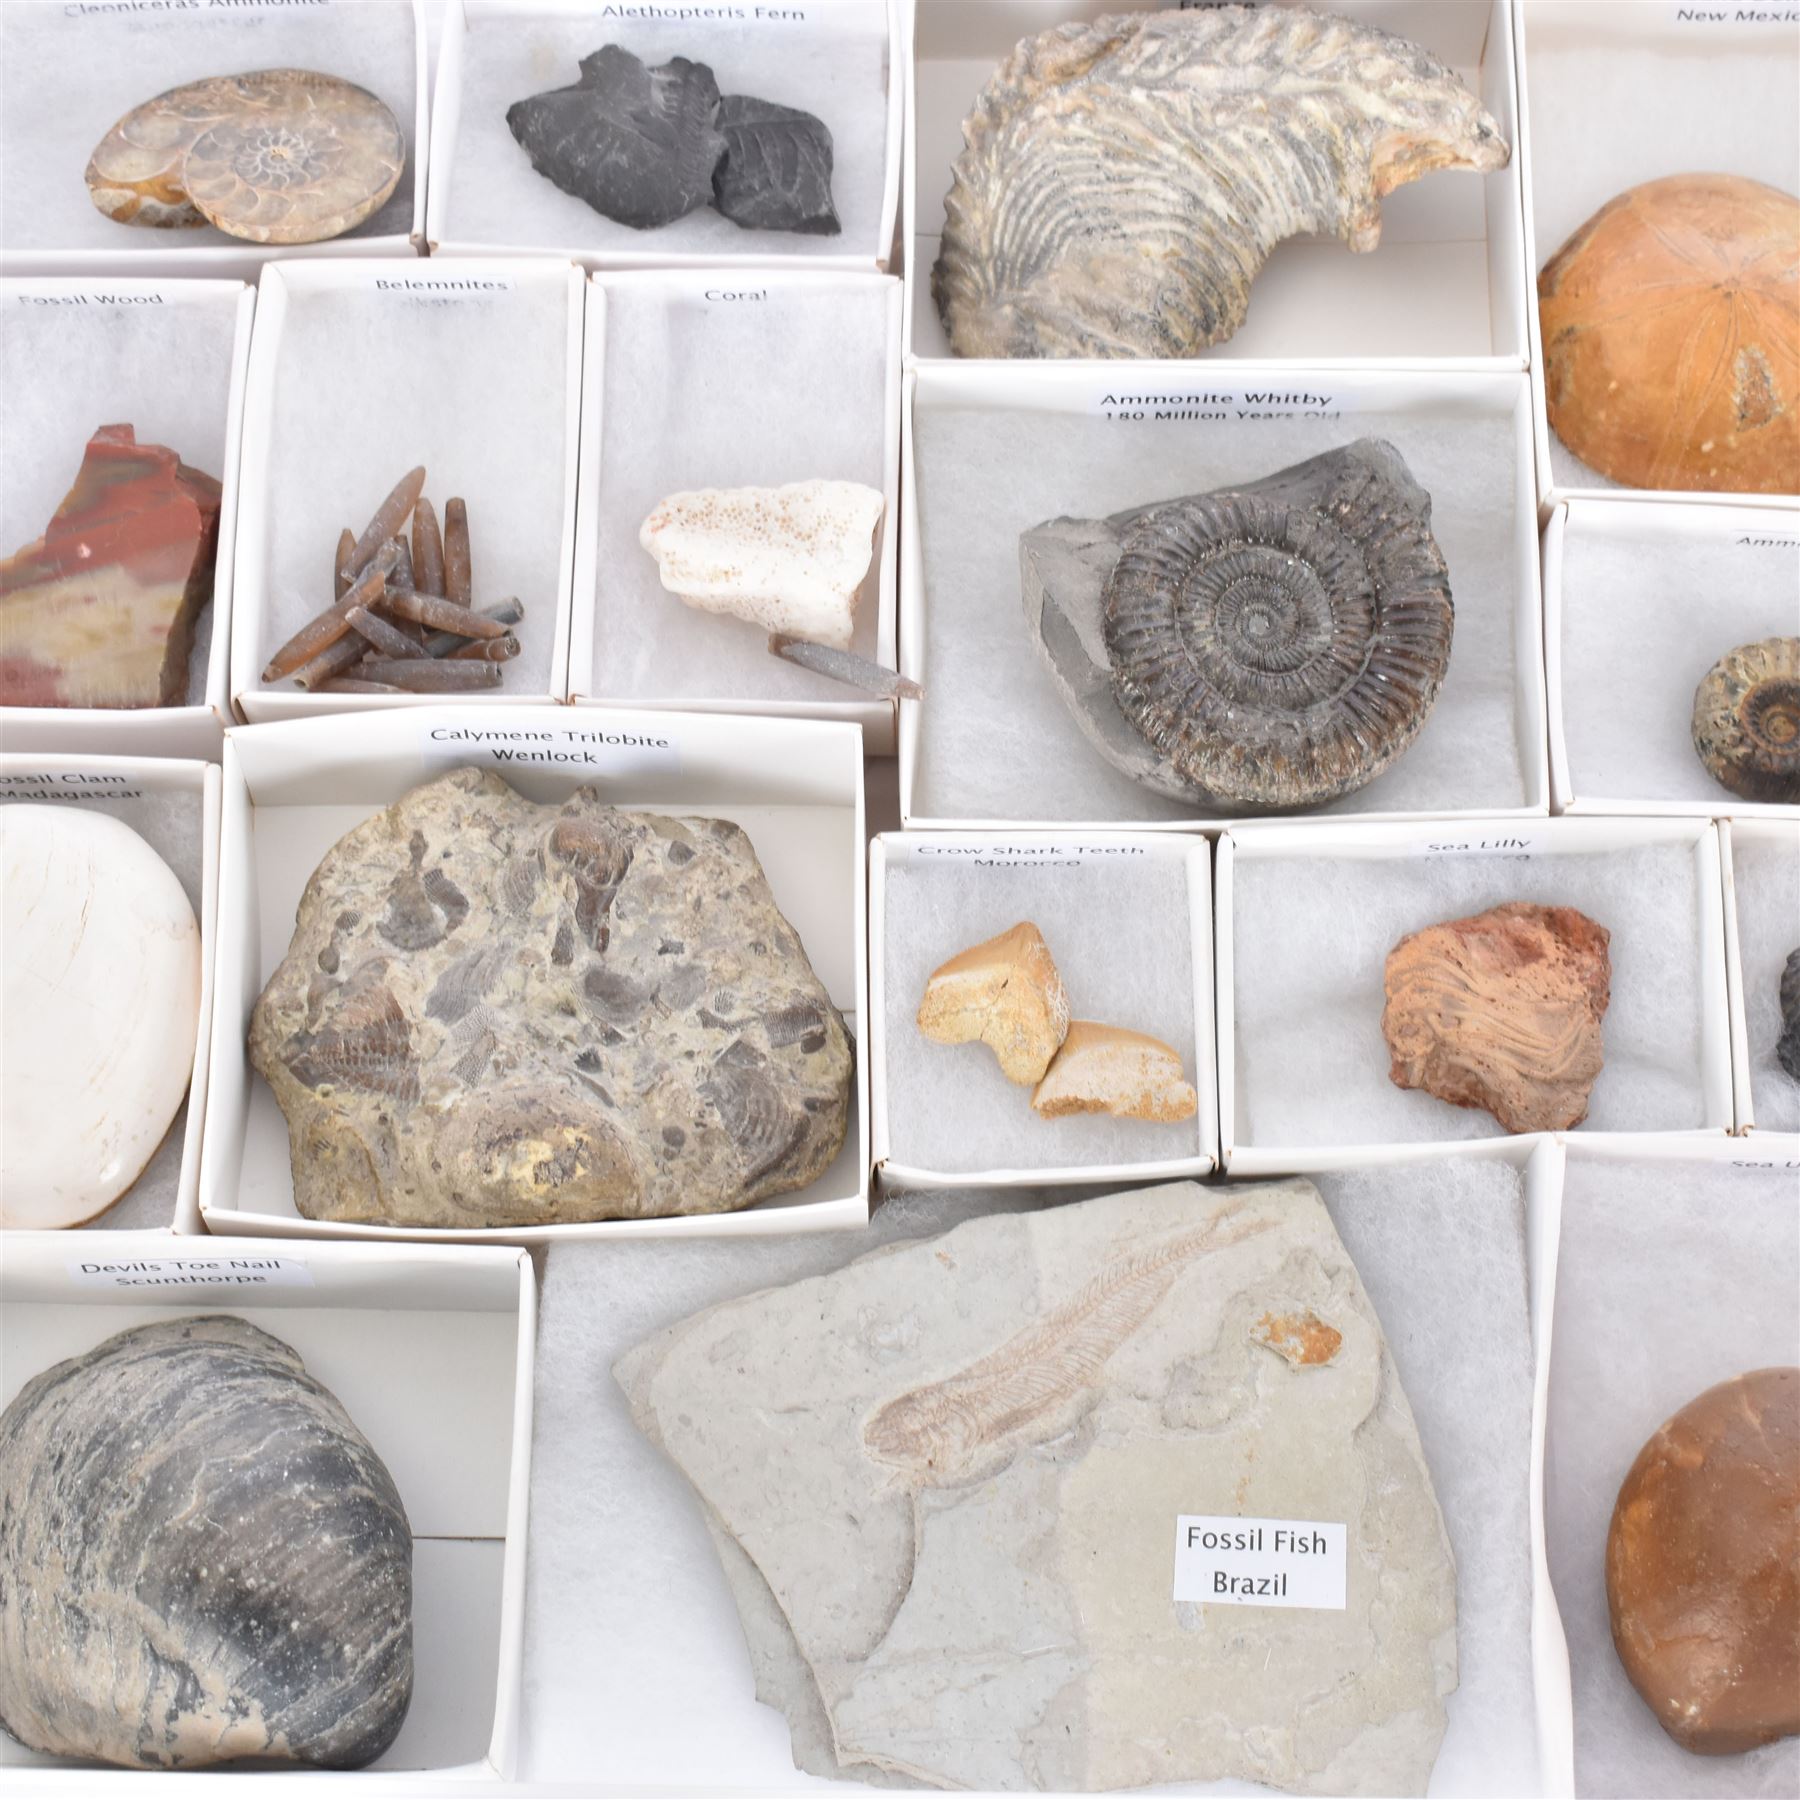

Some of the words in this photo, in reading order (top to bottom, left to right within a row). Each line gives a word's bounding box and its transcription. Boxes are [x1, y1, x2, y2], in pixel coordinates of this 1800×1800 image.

[602, 4, 745, 21] Alethopteris
[754, 6, 806, 21] Fern
[1677, 9, 1726, 21] New
[375, 279, 508, 291] Belemnites
[18, 294, 88, 305] Fossil
[94, 293, 164, 305] Wood
[704, 289, 767, 301] Coral
[1100, 394, 1233, 406] Ammonite
[1244, 393, 1333, 407] Whitby
[1106, 411, 1145, 421] 180
[1154, 410, 1227, 421] Million
[1236, 411, 1295, 420] Years
[1735, 536, 1800, 546] Amm
[430, 728, 553, 742] Calymene
[561, 731, 669, 749] Trilobite
[491, 749, 599, 764] Wenlock
[61, 773, 126, 784] Clam
[917, 846, 984, 855] Crow
[992, 846, 1064, 856] Shark
[1073, 846, 1145, 855] Teeth
[1427, 843, 1470, 852] Sea
[1480, 838, 1531, 849] Lilly
[973, 858, 1082, 867] Morocco
[1731, 1160, 1774, 1169] Sea
[81, 1262, 162, 1274] Devils
[170, 1261, 220, 1271] Toe
[230, 1260, 281, 1270] Nail
[116, 1273, 267, 1287] Scunthorpe
[1187, 1526, 1263, 1552] Fossil
[1274, 1530, 1327, 1555] Fish
[1213, 1570, 1287, 1597] Brazil
